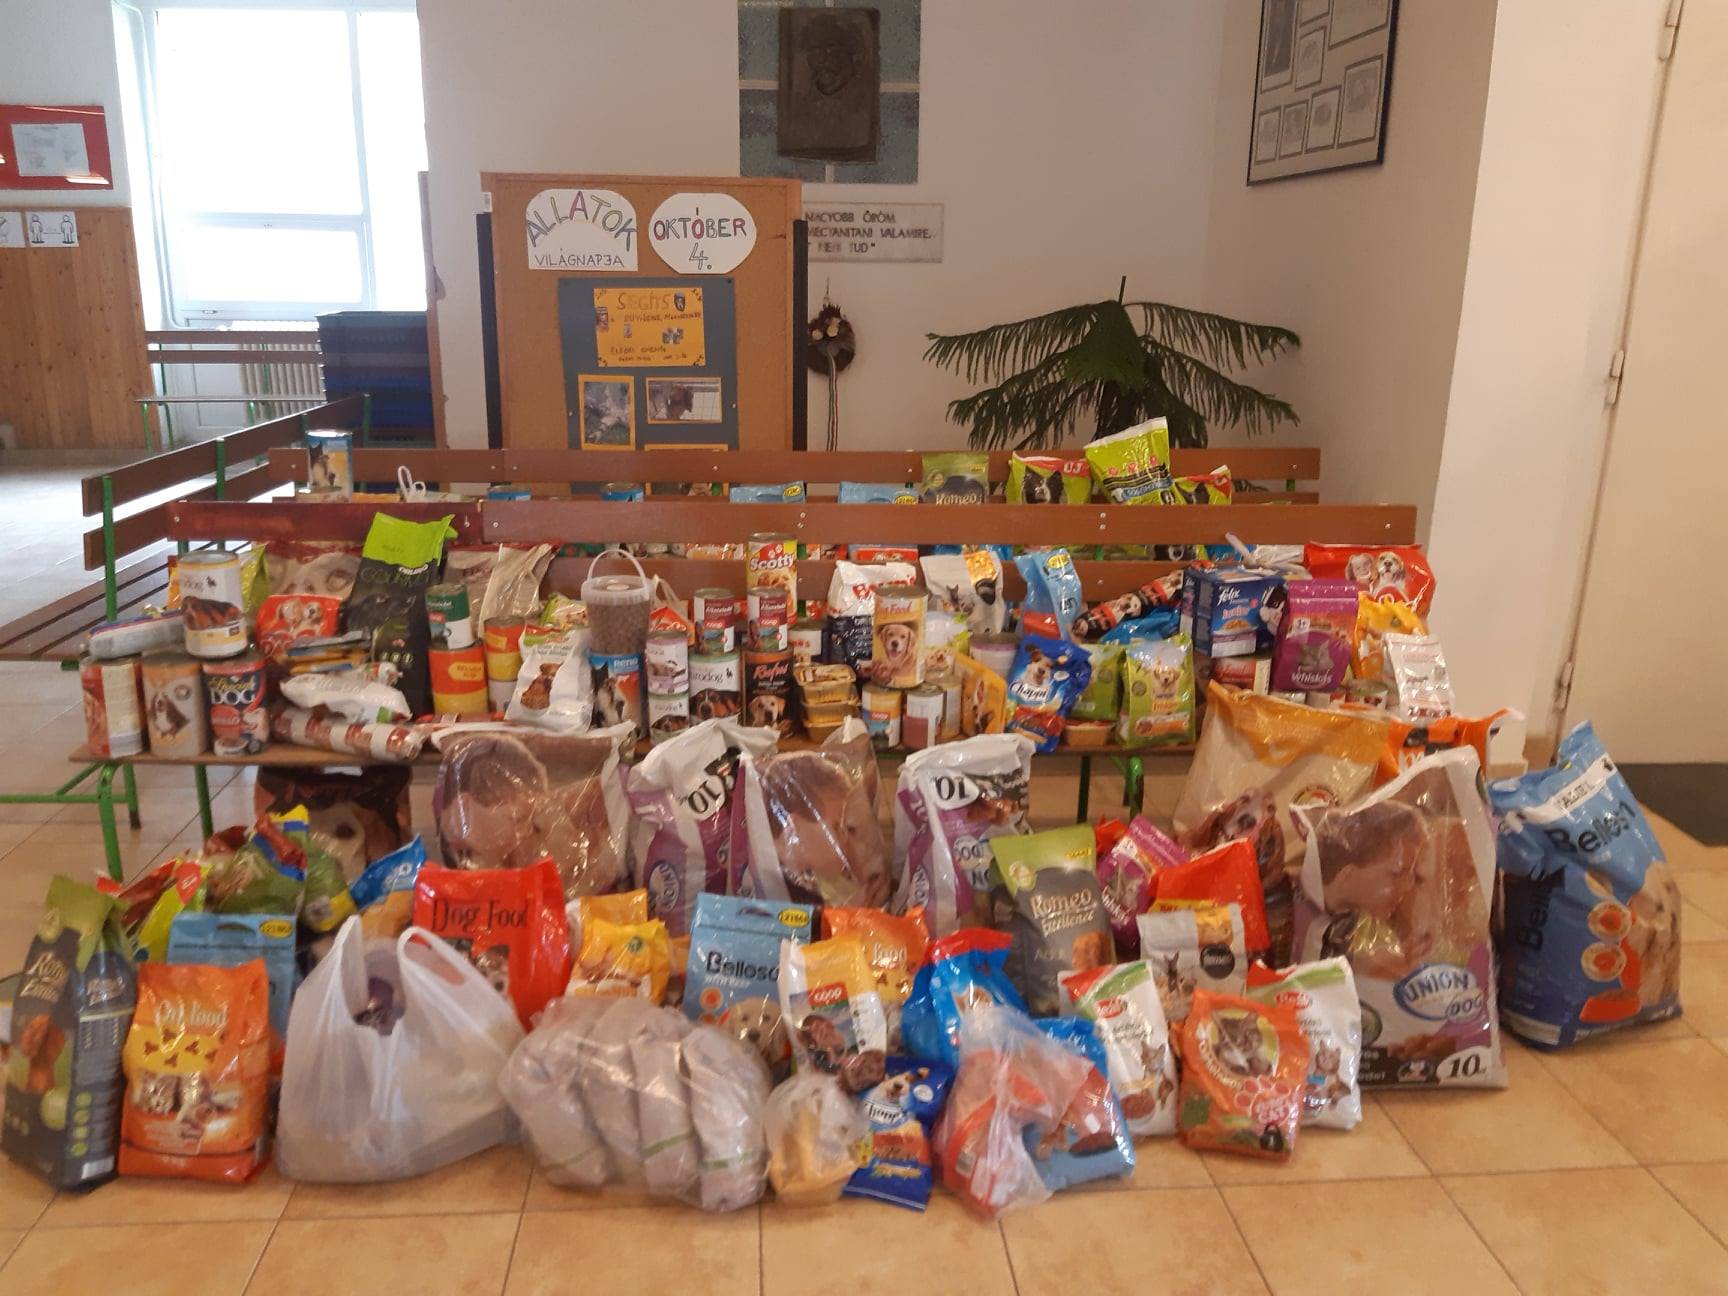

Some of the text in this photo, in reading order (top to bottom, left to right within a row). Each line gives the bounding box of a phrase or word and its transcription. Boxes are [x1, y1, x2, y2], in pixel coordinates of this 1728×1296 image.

[653, 207, 747, 241] OKTÓBER
[750, 553, 796, 571] Scotty
[432, 898, 481, 932] Dog
[1030, 888, 1092, 919] Romeo
[1404, 973, 1469, 1002] UNION
[1451, 1054, 1481, 1078] 10
